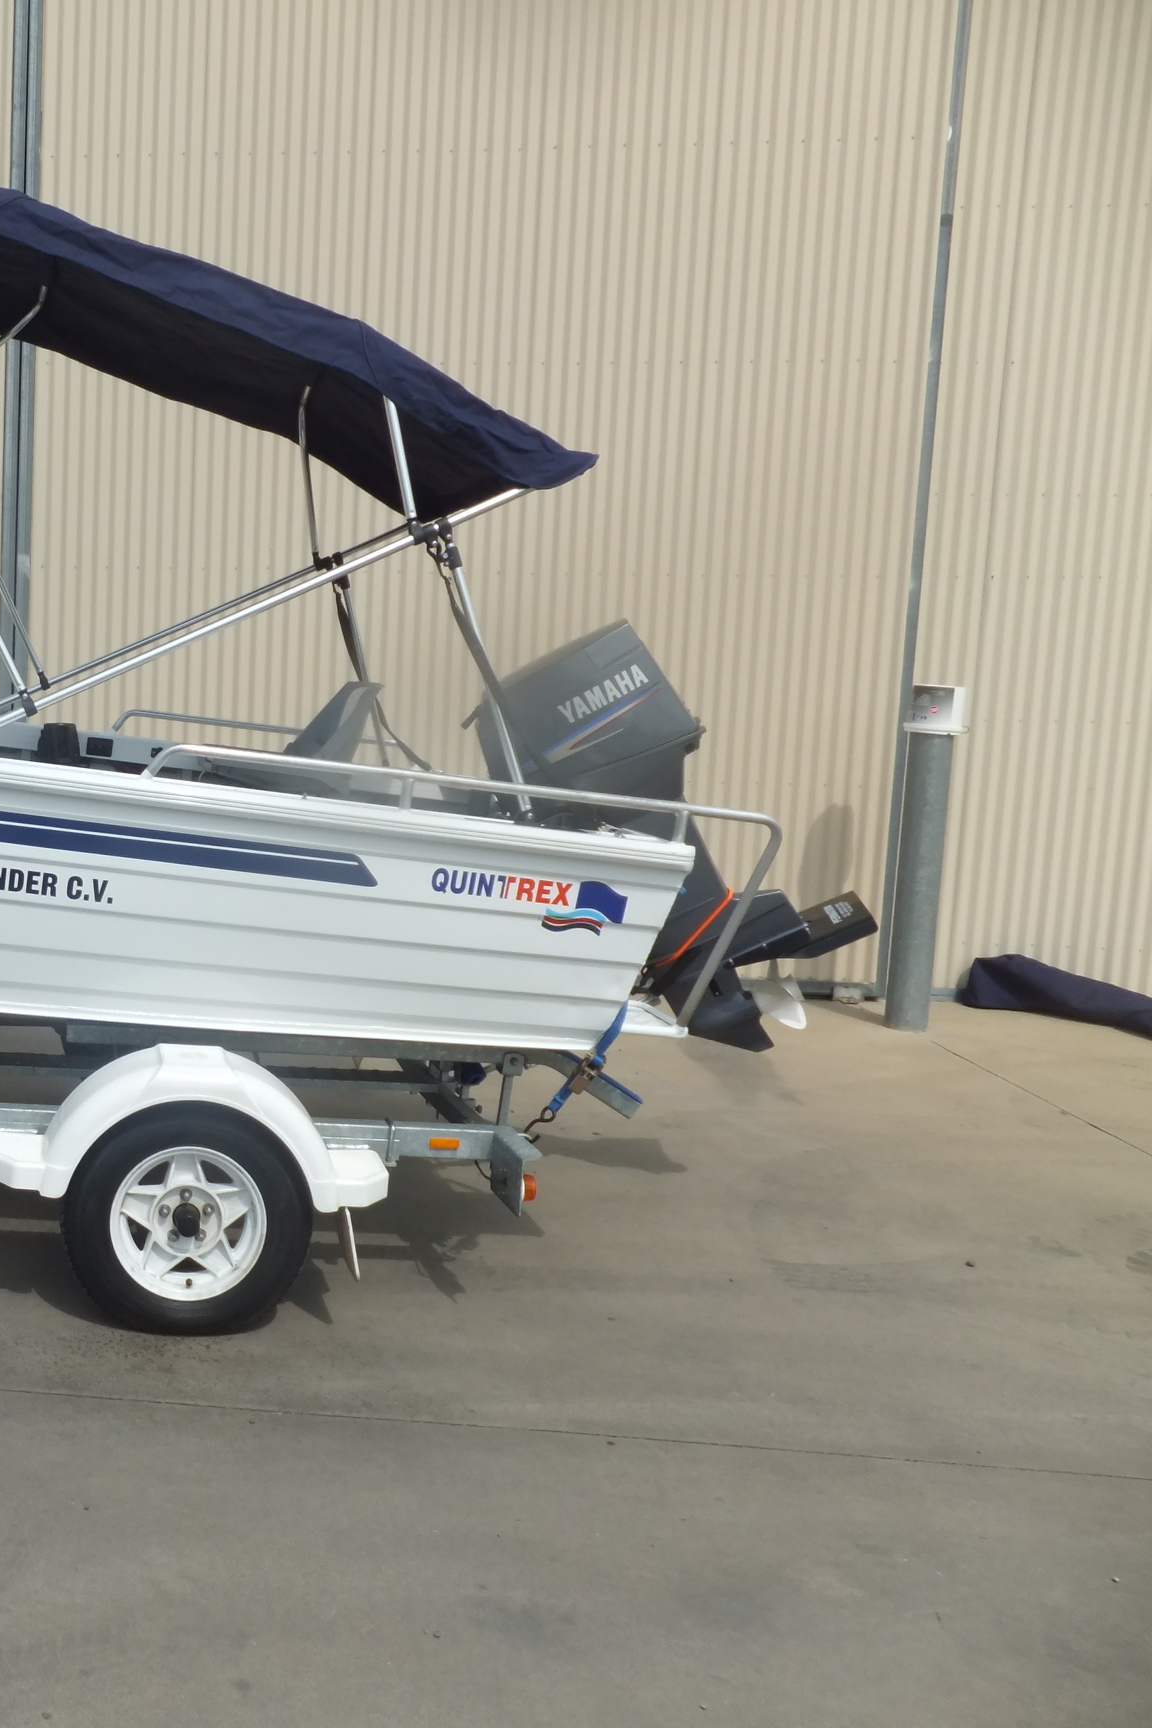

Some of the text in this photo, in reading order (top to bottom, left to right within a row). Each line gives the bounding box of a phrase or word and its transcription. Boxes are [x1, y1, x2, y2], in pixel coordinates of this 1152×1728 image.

[557, 664, 649, 723] YAMAHA
[66, 875, 114, 904] C.V.
[431, 867, 573, 907] QUINTREX
